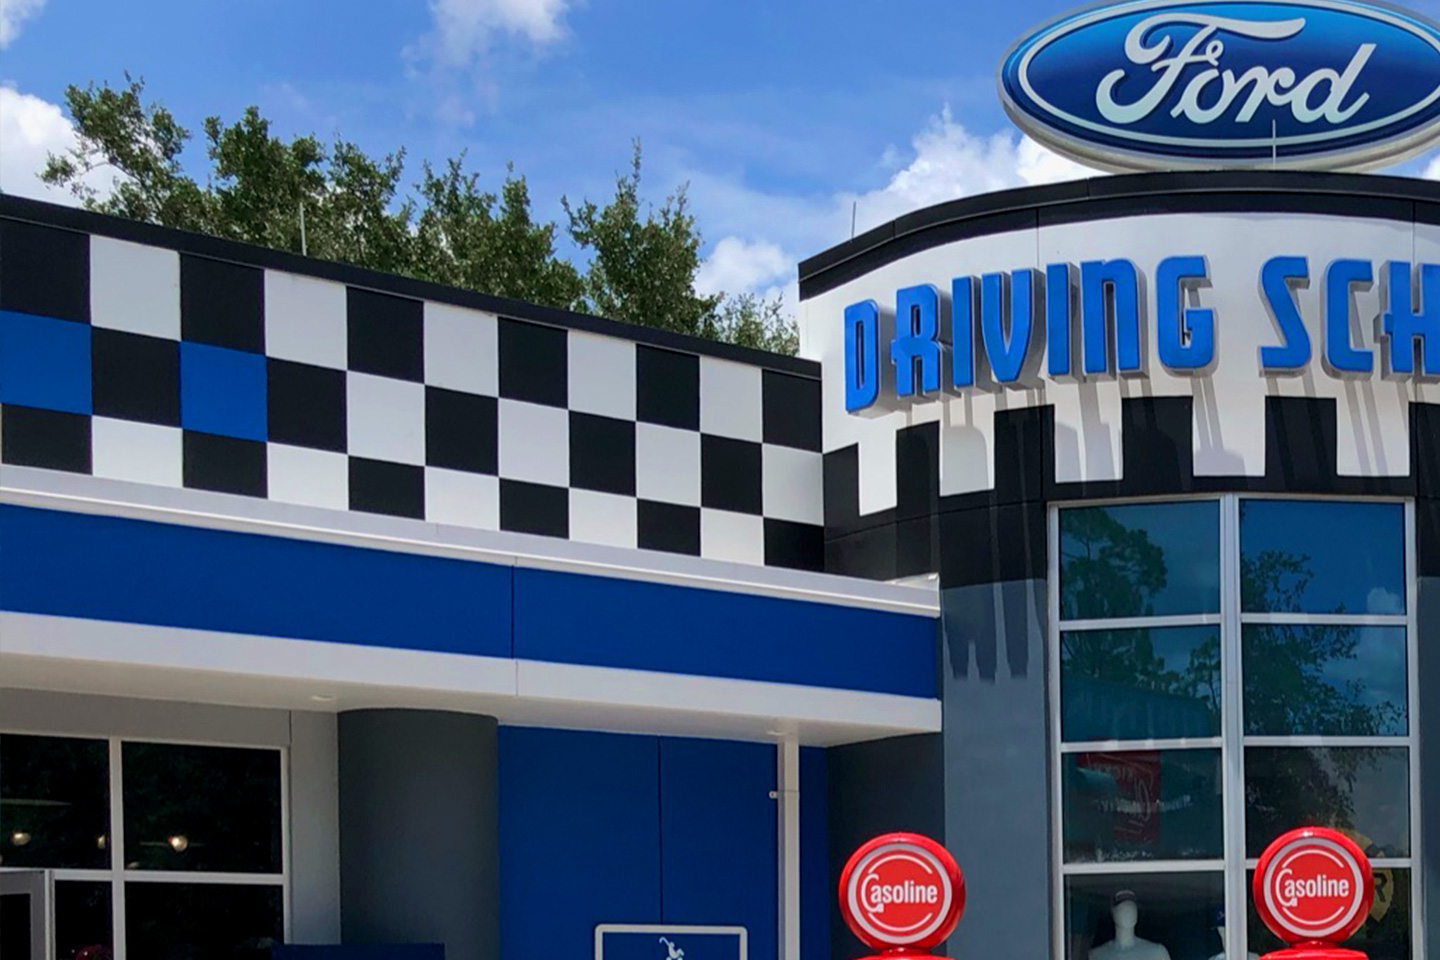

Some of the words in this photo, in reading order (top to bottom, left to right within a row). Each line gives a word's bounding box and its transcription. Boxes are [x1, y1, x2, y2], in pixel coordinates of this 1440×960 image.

[1096, 12, 1377, 125] Ford
[844, 255, 1216, 415] DRIVING
[861, 873, 938, 913] Gasoline
[1275, 868, 1349, 907] Gasoline
